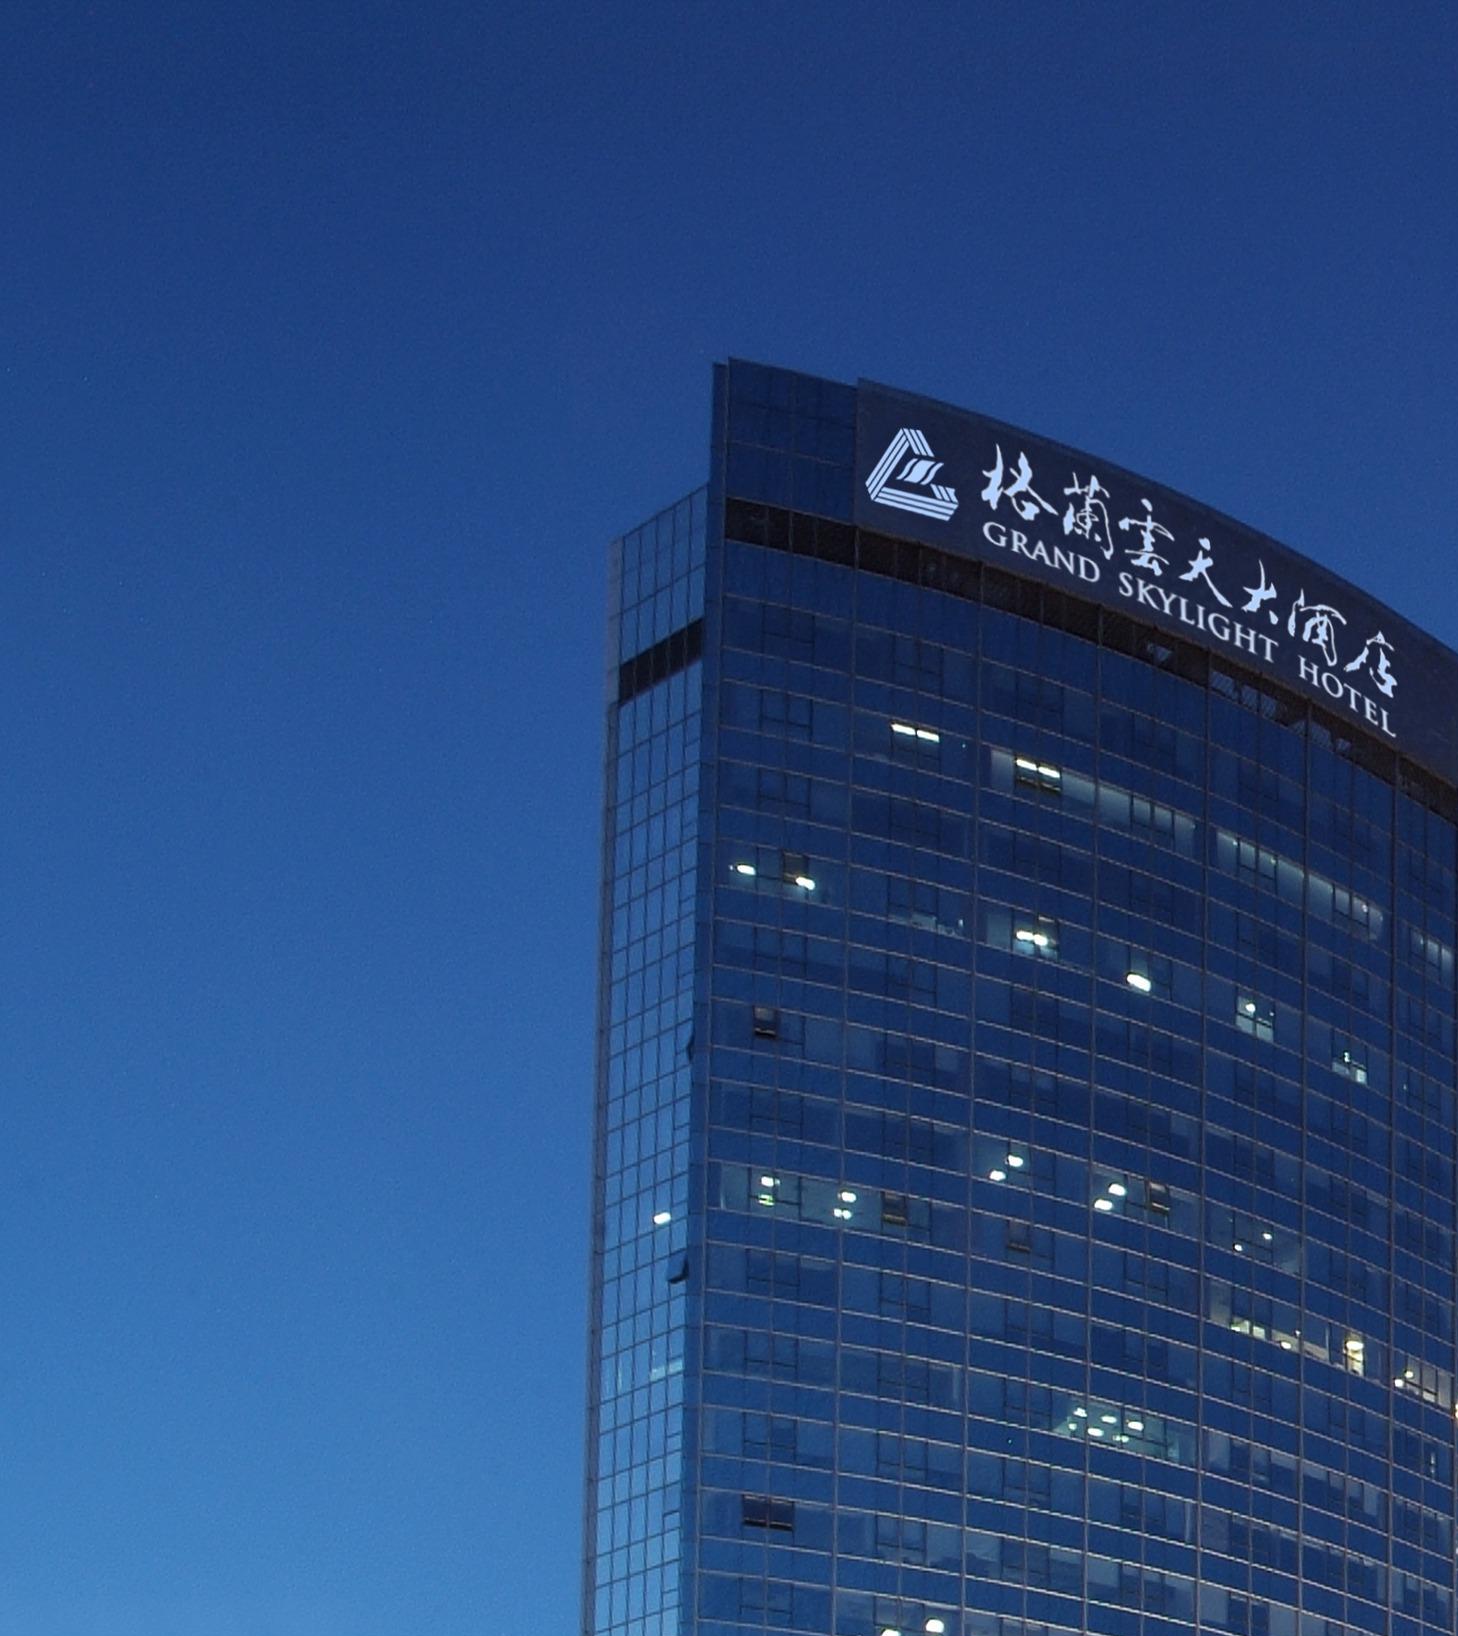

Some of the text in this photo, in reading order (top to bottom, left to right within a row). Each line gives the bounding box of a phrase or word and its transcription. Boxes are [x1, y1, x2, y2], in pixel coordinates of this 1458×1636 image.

[983, 521, 1397, 738] GRAND SKYLIGHT HOTEL
